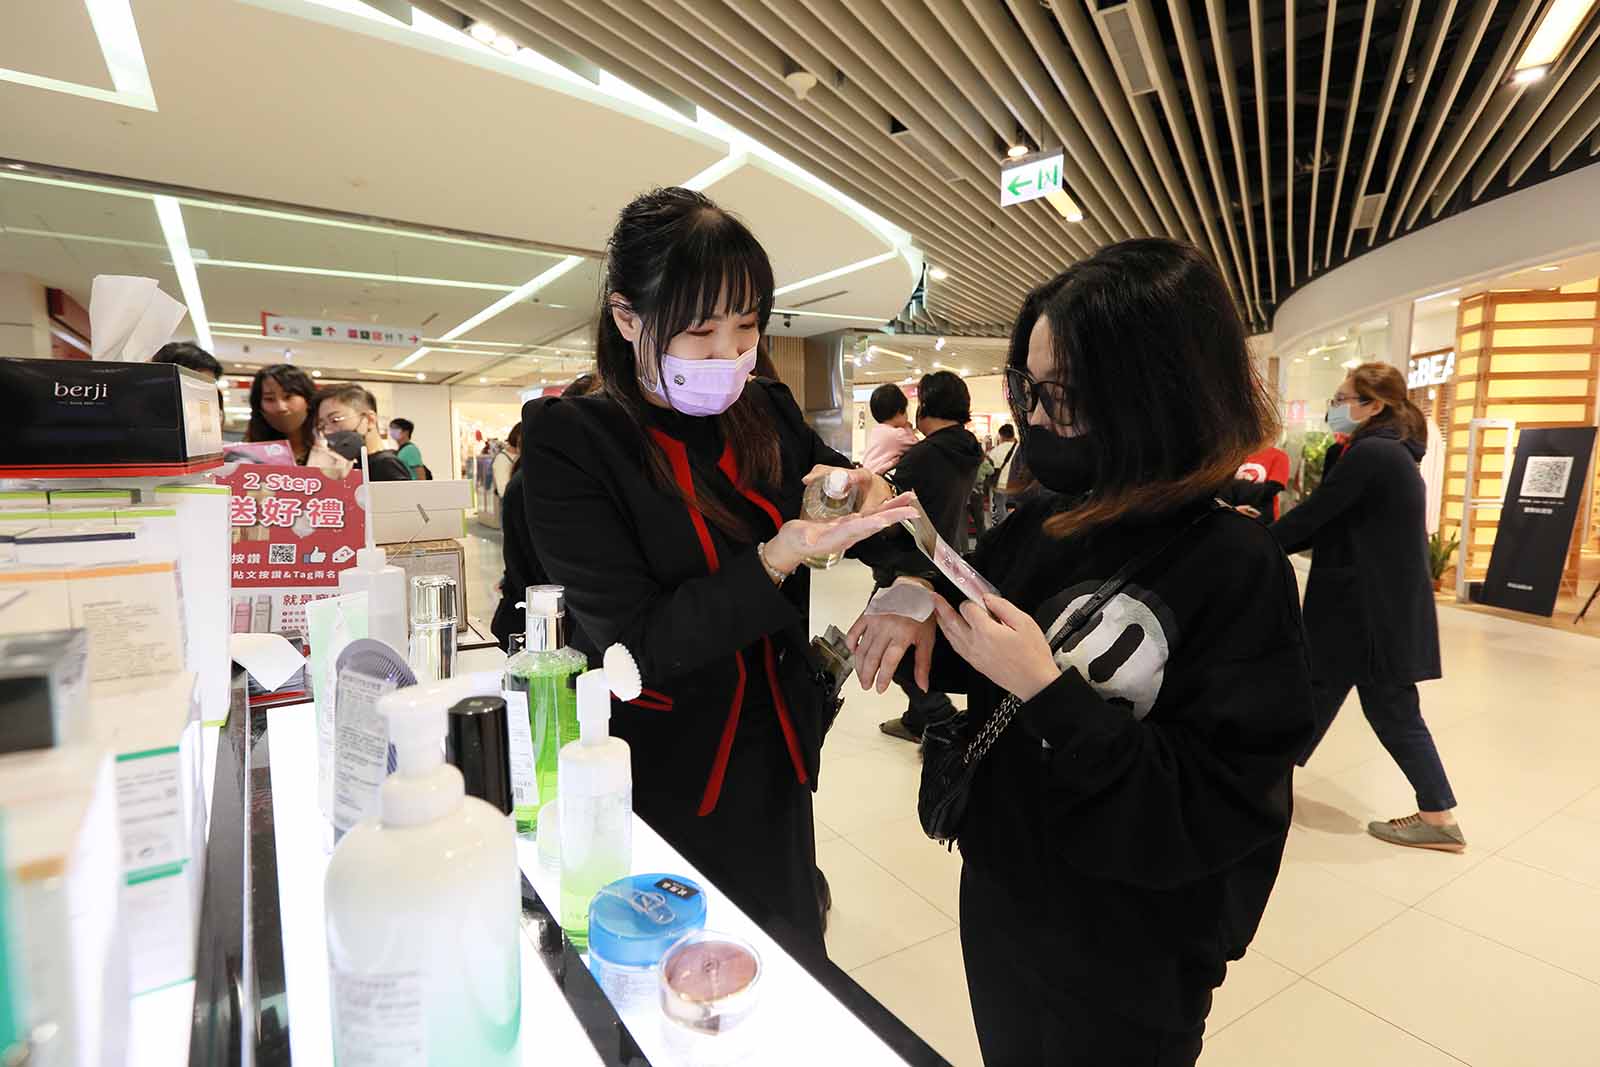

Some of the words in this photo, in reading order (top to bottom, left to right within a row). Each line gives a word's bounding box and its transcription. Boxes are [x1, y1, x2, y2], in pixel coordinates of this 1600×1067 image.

[54, 382, 107, 401] berji
[243, 472, 260, 489] 2
[265, 473, 321, 495] Step
[231, 495, 344, 528] 送好禮
[282, 593, 342, 606] 就是
